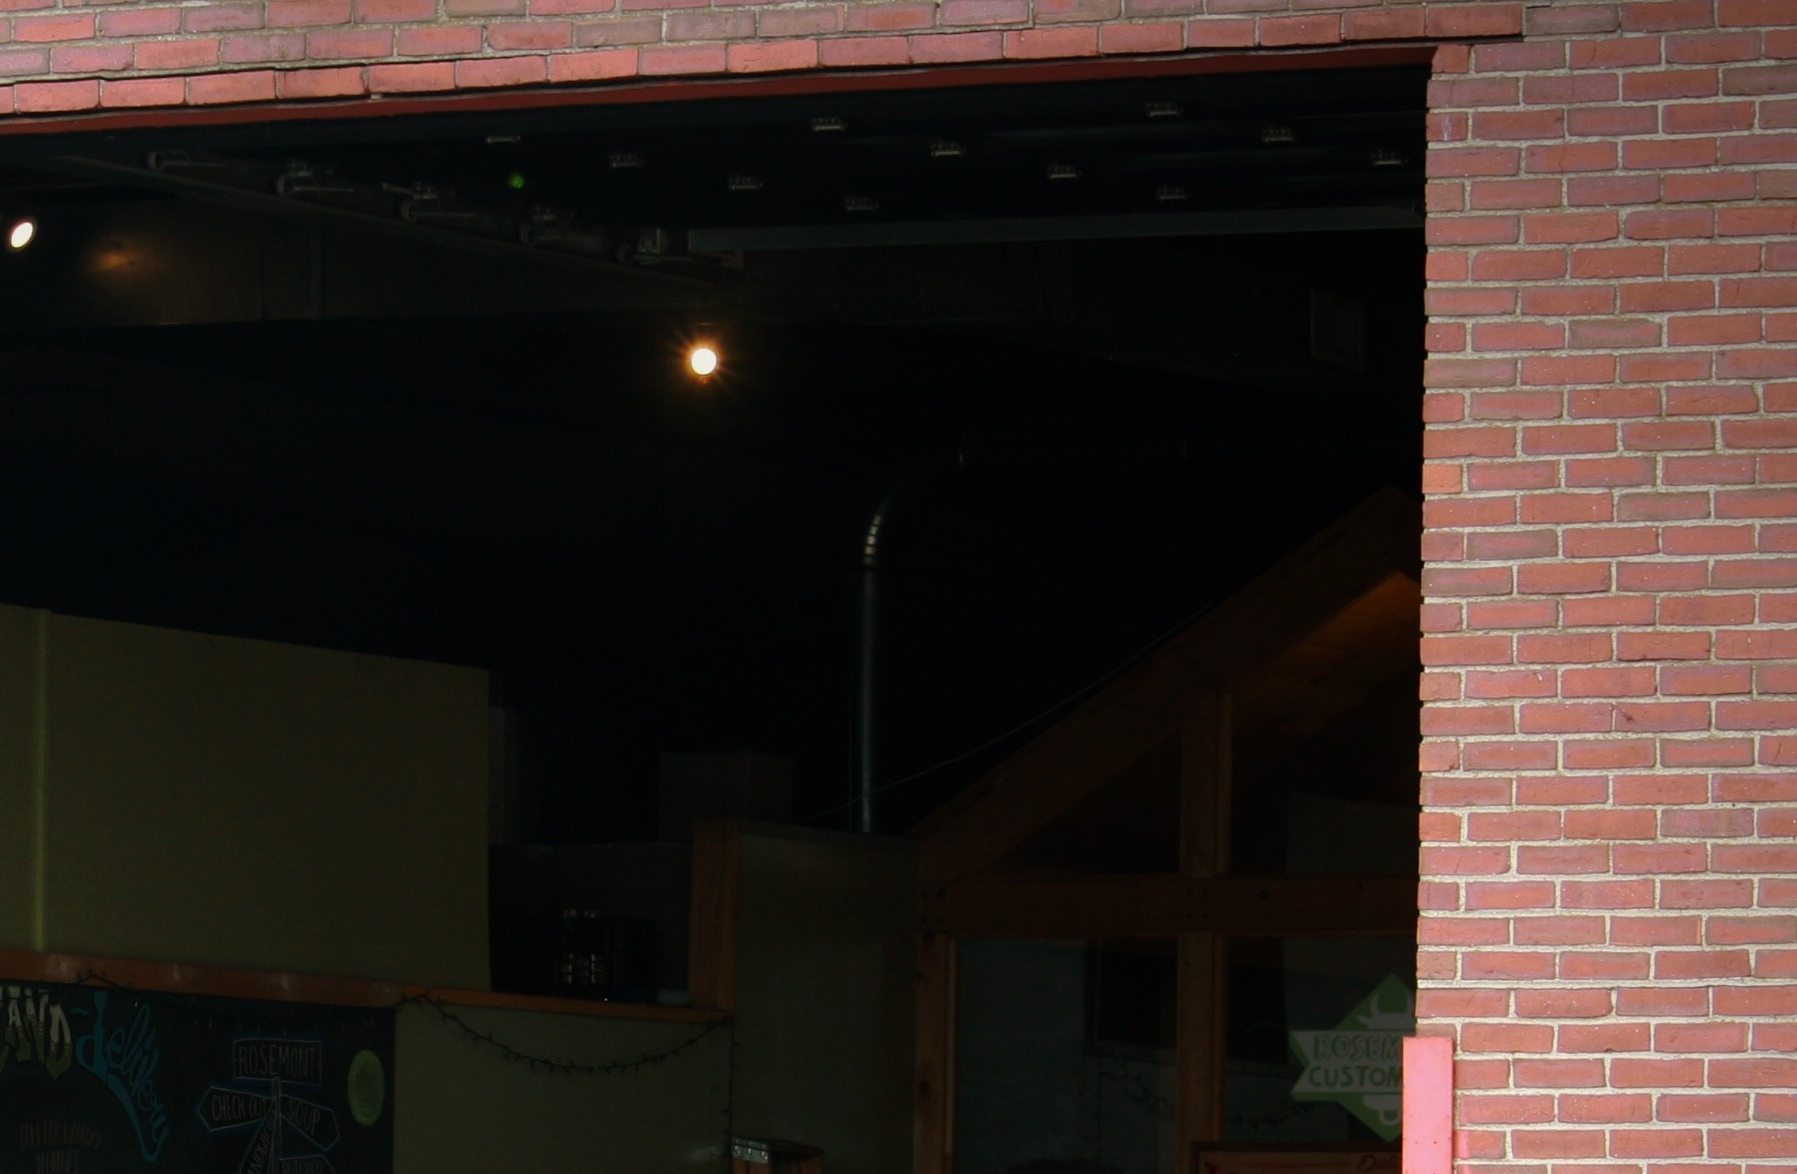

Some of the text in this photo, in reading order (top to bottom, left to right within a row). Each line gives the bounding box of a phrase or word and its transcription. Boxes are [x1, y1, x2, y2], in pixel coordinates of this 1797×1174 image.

[238, 1044, 317, 1079] ROSEMONT
[1314, 1034, 1401, 1060] ROSEM
[211, 1094, 246, 1121] CHECK
[288, 1099, 321, 1136] SOUP
